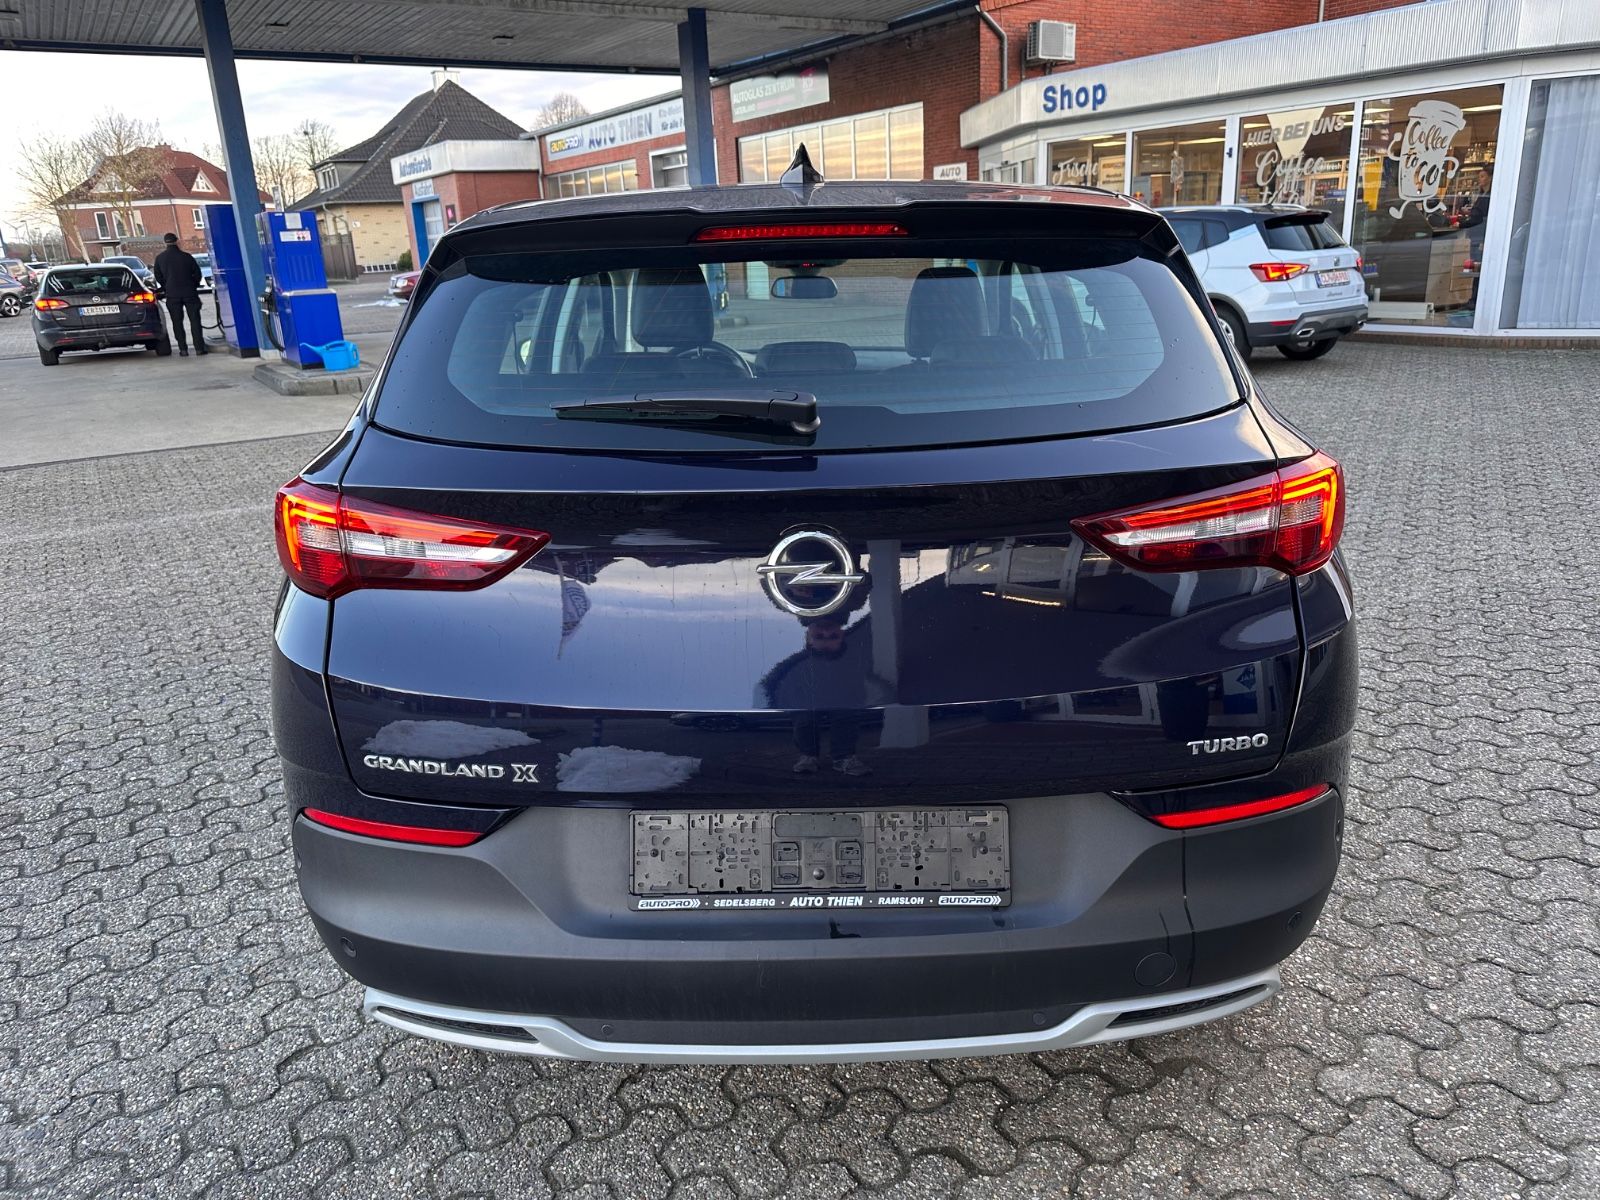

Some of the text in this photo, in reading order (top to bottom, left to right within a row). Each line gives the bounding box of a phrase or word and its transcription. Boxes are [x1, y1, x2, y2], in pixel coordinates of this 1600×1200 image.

[1043, 83, 1107, 113] Shop
[588, 122, 616, 149] AUTO
[618, 111, 653, 142] THIEN
[1247, 115, 1346, 144] HIER BEI UNS
[1408, 121, 1448, 151] Coffee
[940, 167, 961, 178] AUTO
[1256, 149, 1325, 193] Coffee
[1186, 733, 1269, 755] TURBO
[363, 754, 539, 783] GRANDLAND X
[713, 898, 776, 907] SEDELSBERG
[790, 896, 824, 907] AUTO
[827, 896, 863, 906] THIEN
[878, 897, 924, 905] RAMSLOH
